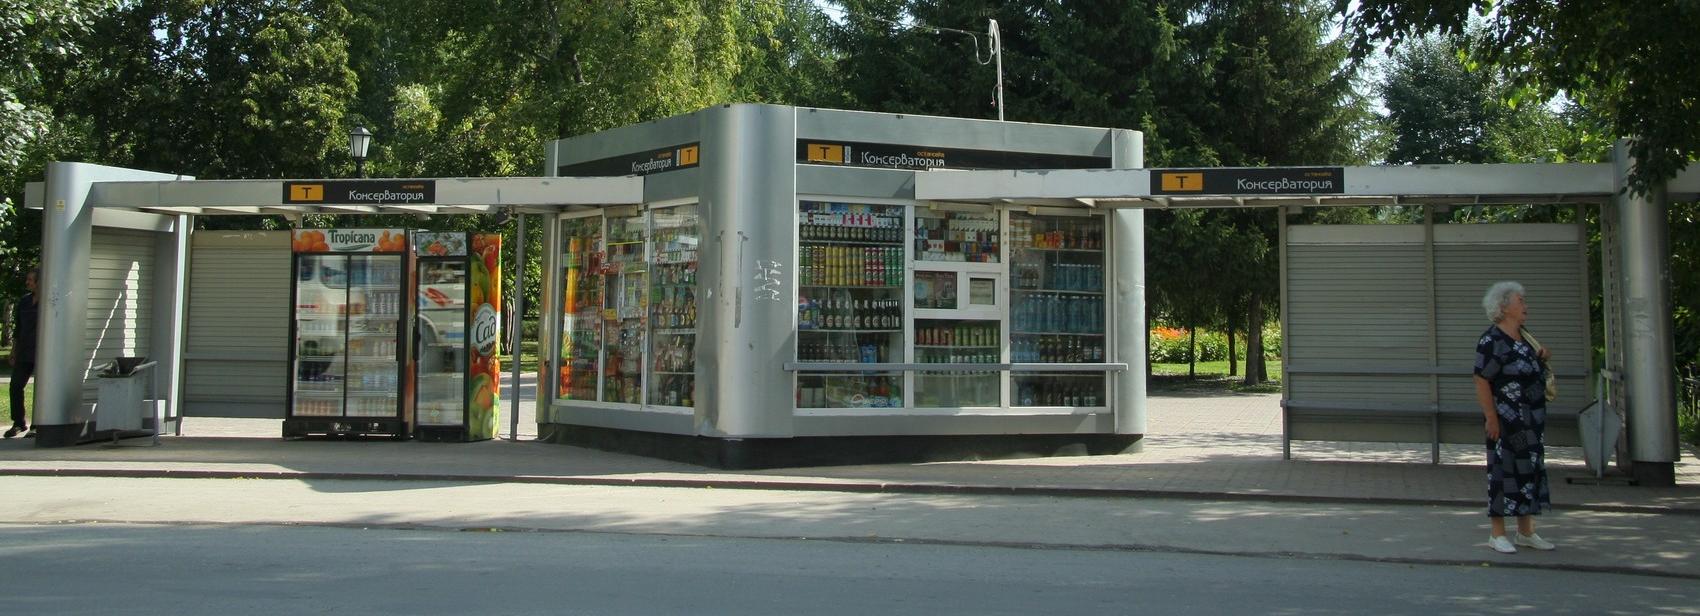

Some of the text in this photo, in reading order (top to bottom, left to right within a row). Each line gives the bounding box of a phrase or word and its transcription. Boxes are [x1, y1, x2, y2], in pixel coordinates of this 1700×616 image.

[861, 151, 945, 169] Консерватория
[1237, 178, 1333, 192] Консерватория
[349, 190, 424, 203] Консерватория
[328, 229, 376, 244] Tropicana
[476, 315, 497, 344] Сад
